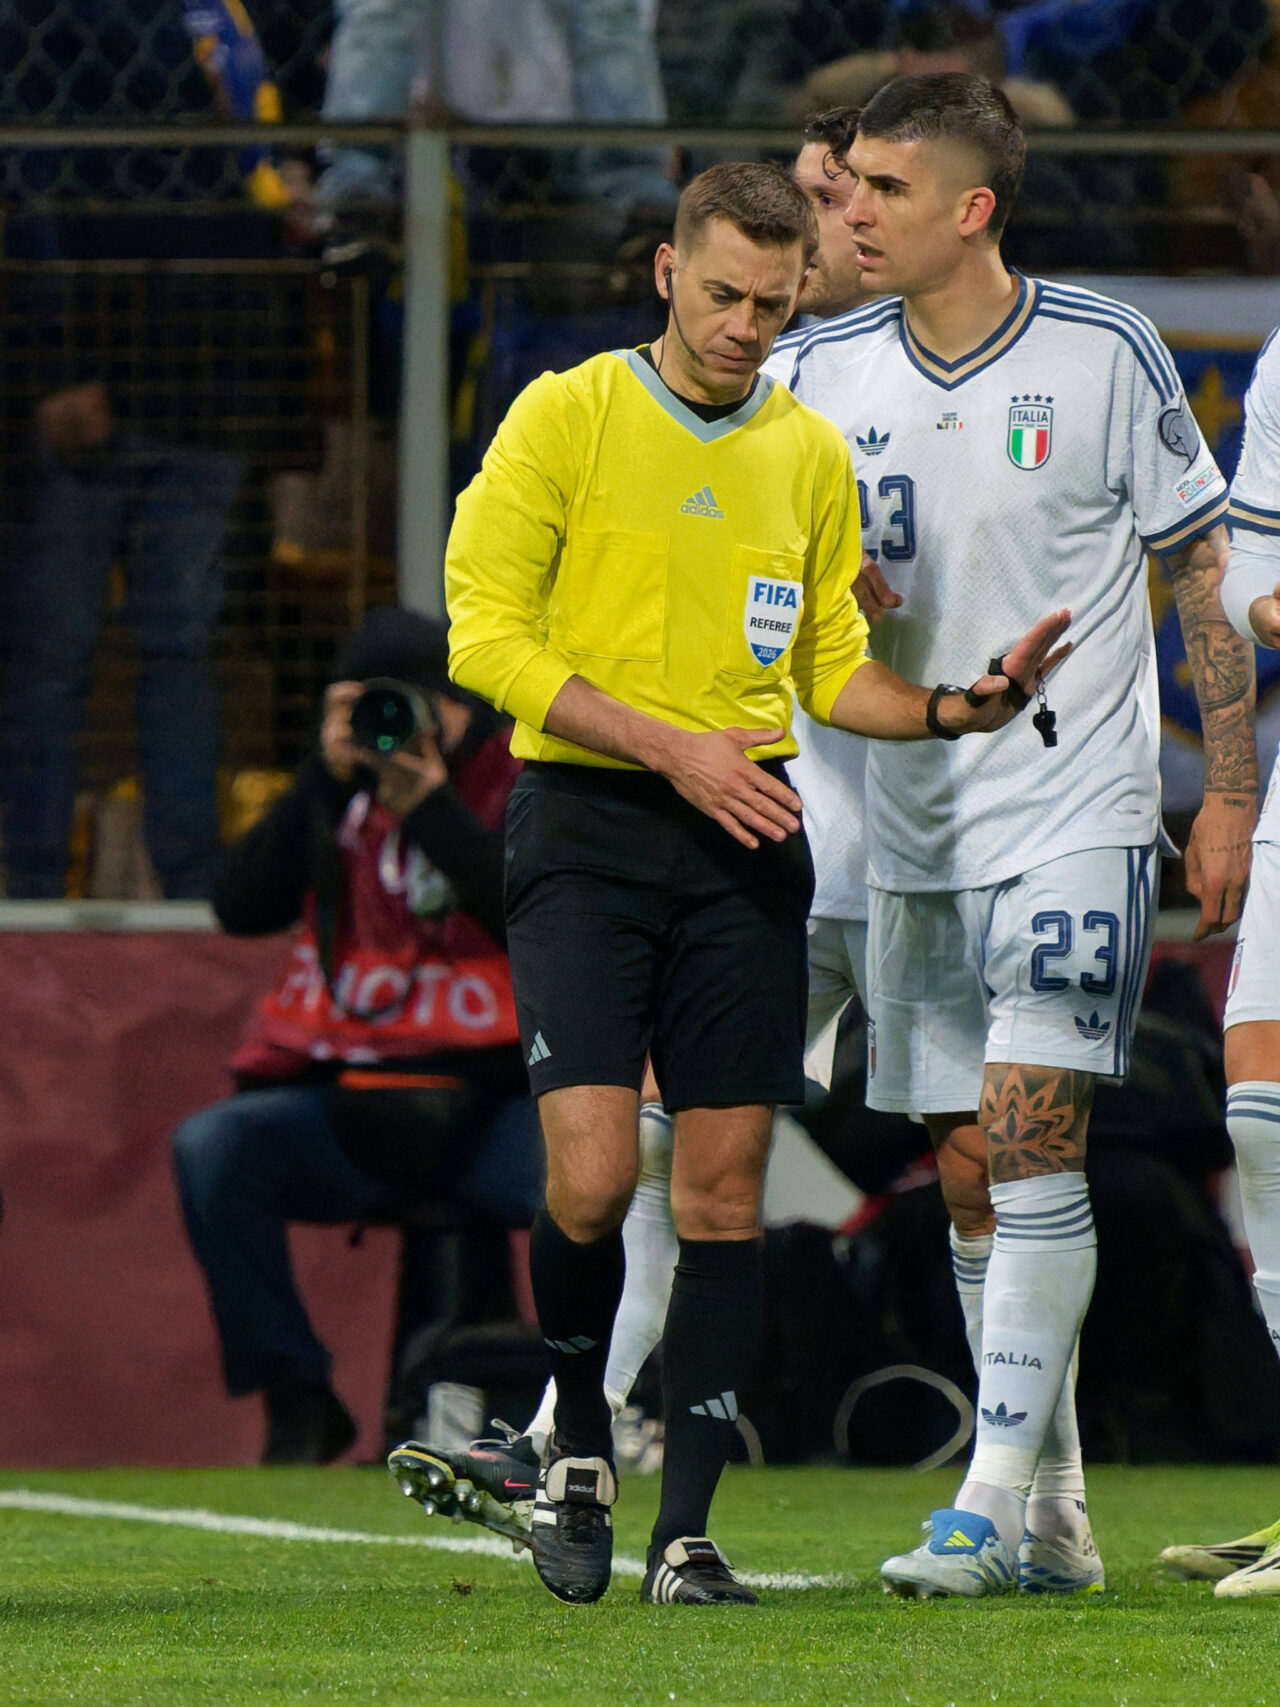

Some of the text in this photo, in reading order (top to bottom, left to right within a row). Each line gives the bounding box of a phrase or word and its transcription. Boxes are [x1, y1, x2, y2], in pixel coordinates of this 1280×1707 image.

[1012, 410, 1049, 423] ITALIA
[680, 503, 724, 519] adidas
[753, 582, 797, 609] FIFA
[750, 617, 792, 633] REFEREE
[757, 646, 777, 660] 2026
[1030, 909, 1120, 997] 23
[984, 1351, 1042, 1371] ITALIA
